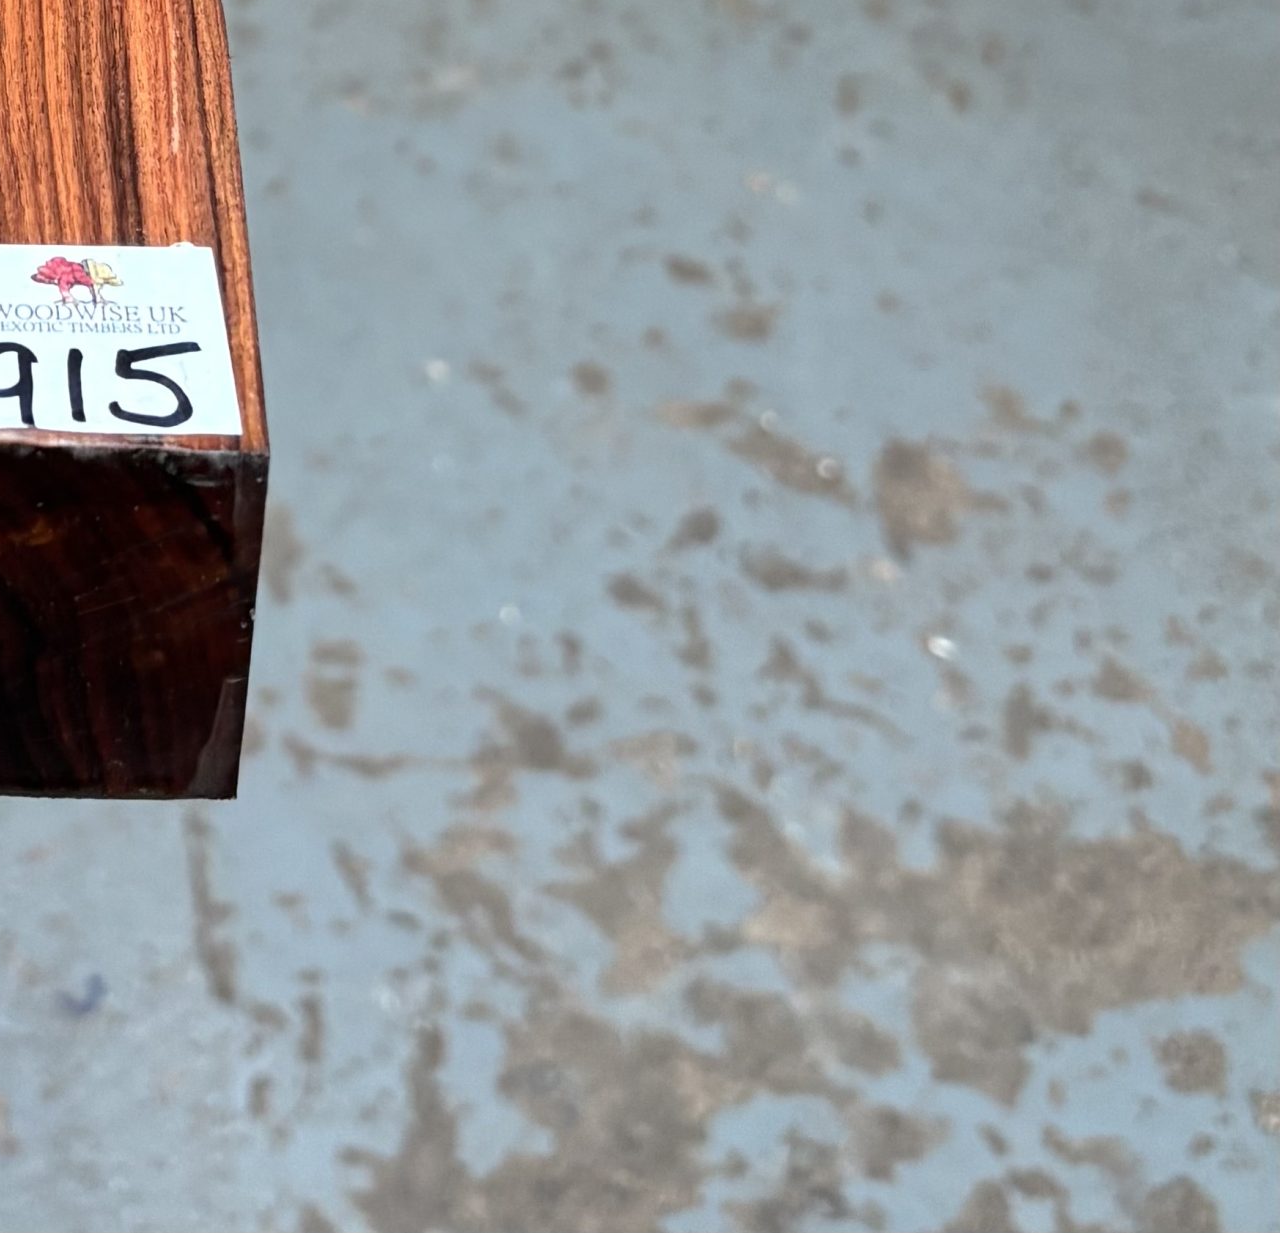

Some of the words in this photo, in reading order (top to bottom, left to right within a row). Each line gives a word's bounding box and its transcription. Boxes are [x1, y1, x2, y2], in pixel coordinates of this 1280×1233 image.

[149, 305, 188, 323] UK
[0, 321, 63, 333] EXOTIC
[68, 322, 143, 334] TIMBERS
[147, 323, 181, 335] LTD
